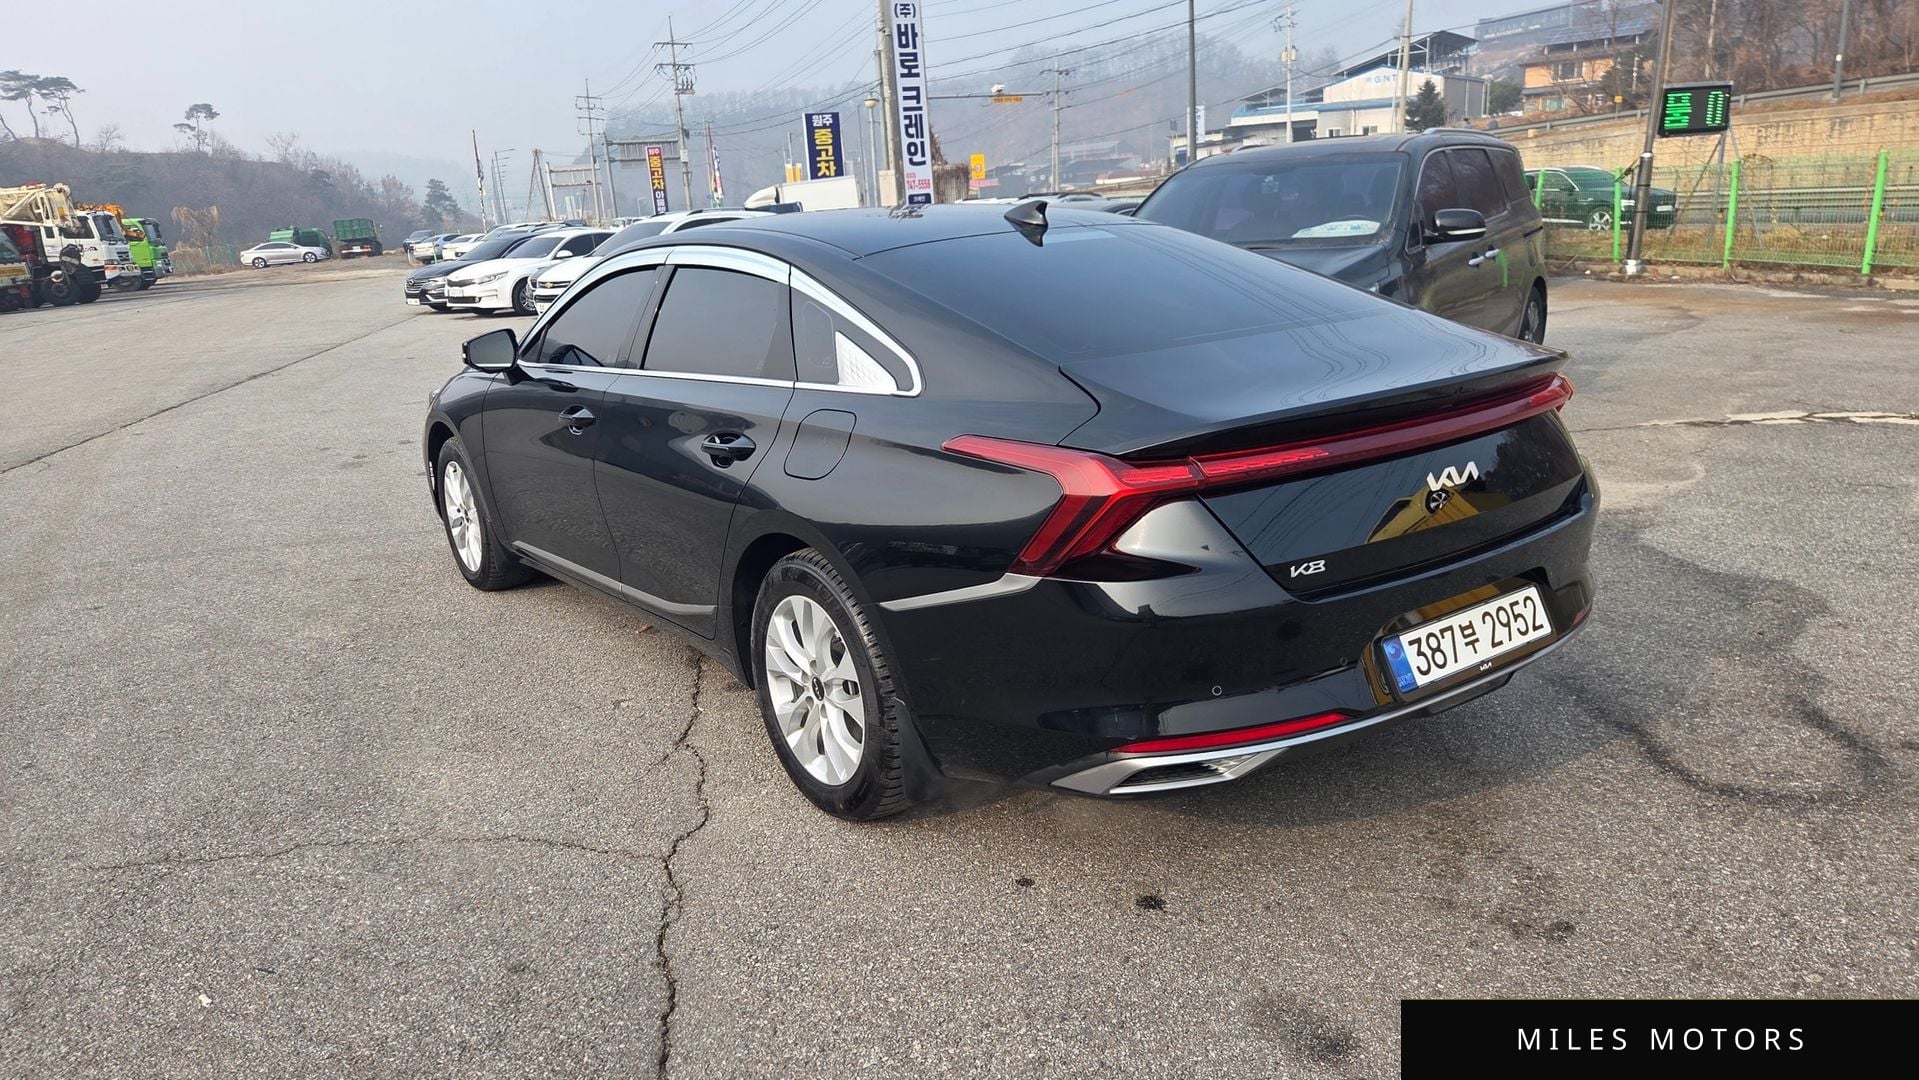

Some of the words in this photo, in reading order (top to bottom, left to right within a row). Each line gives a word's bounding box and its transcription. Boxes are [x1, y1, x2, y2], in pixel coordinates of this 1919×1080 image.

[812, 114, 833, 127] 원주
[814, 128, 836, 177] 중고차
[649, 155, 665, 190] 중고차
[1426, 461, 1479, 491] KIA
[1290, 559, 1326, 578] K8
[1408, 620, 1480, 676] 387부
[1482, 595, 1544, 649] 2952
